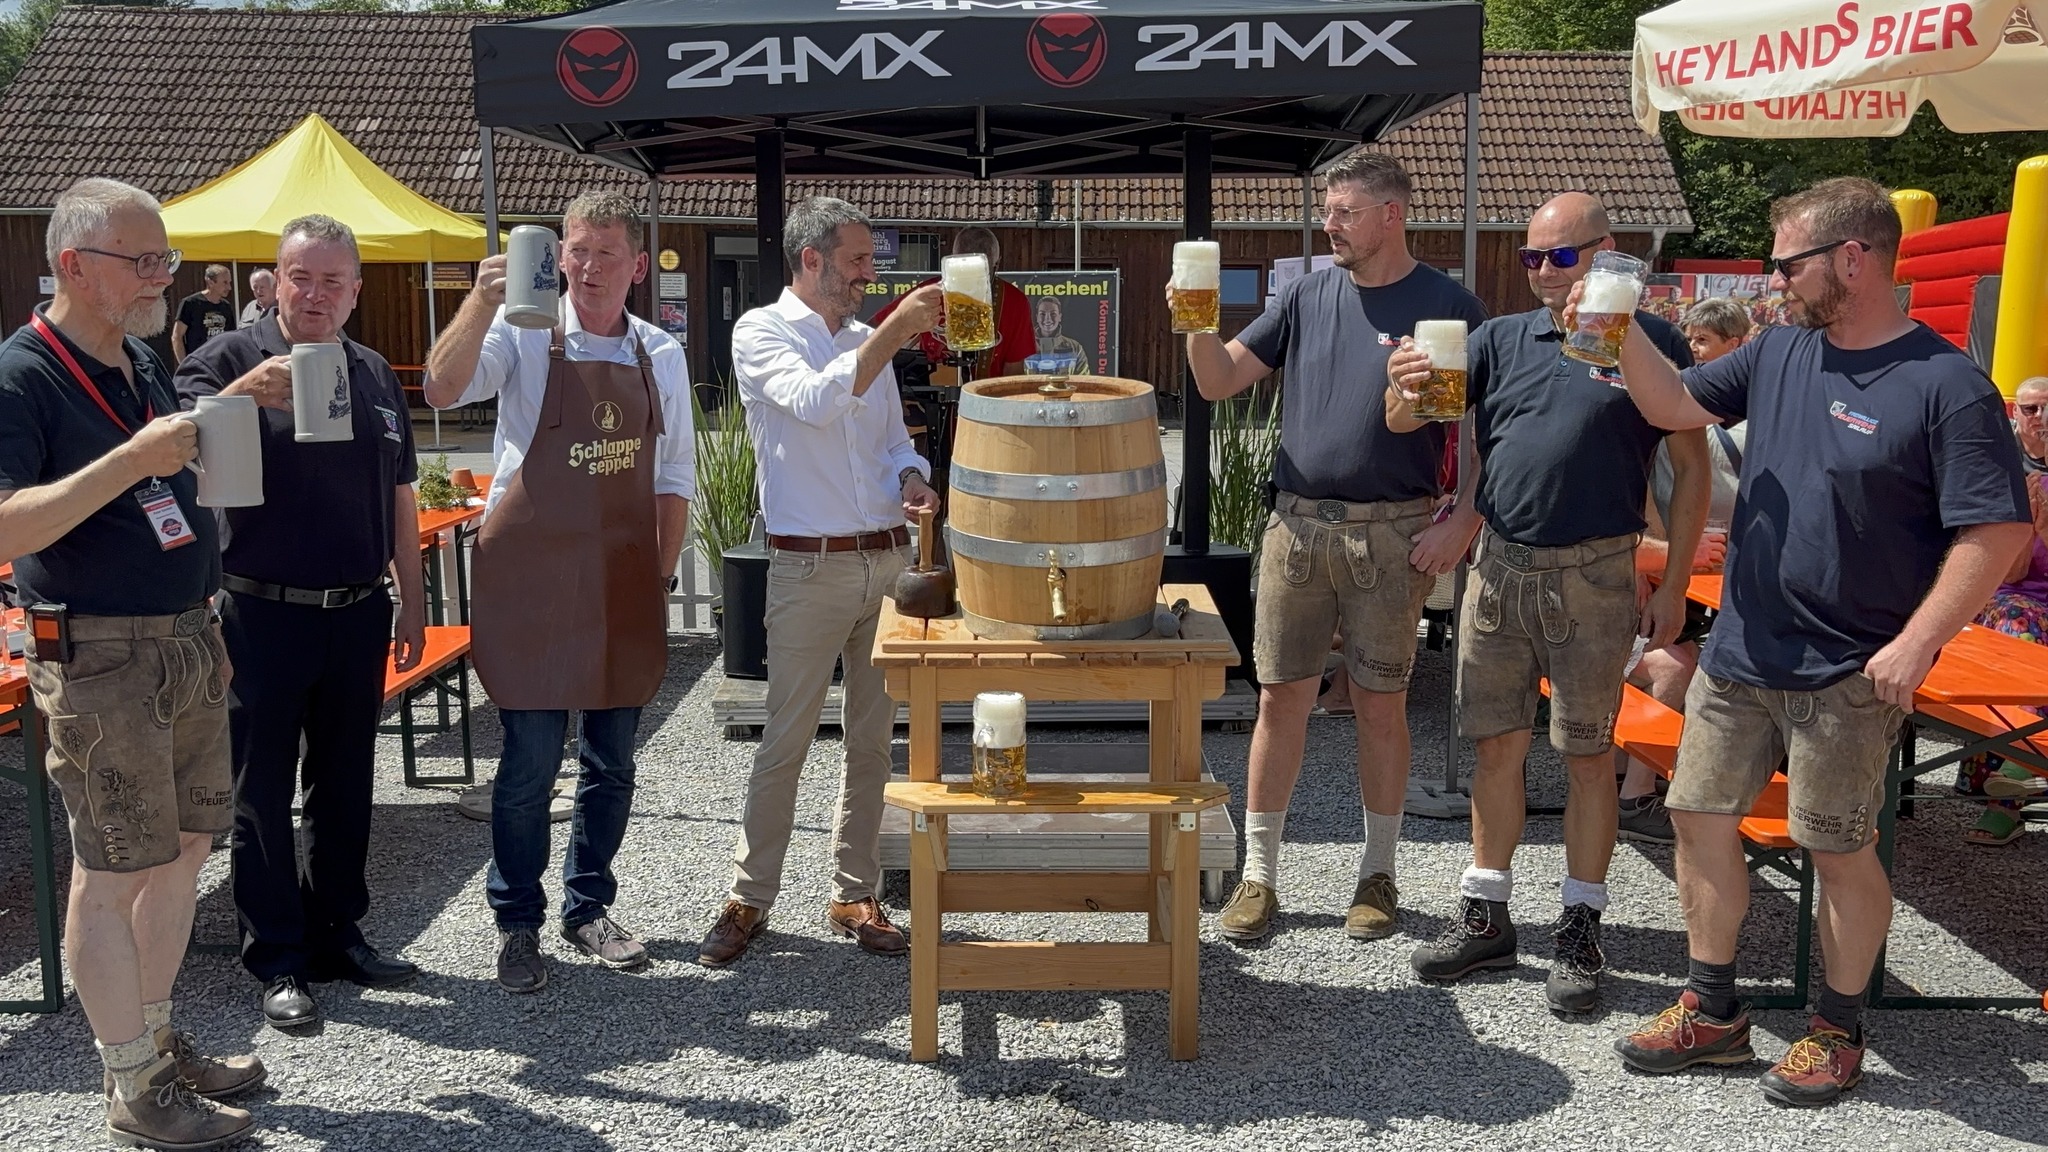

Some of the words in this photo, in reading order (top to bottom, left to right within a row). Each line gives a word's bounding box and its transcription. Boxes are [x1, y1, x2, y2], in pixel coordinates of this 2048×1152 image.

[1865, 3, 1978, 59] BIER
[1135, 20, 1418, 71] 24MX
[667, 30, 952, 89] 24MX
[865, 282, 888, 295] as
[1024, 280, 1108, 296] machen!
[1098, 300, 1109, 355] Könntest
[1098, 358, 1108, 374] Du
[568, 437, 642, 468] Schlappe
[588, 452, 636, 476] seppel
[1552, 719, 1599, 735] EUERWEHR
[1790, 806, 1843, 829] EUERWEHR
[1805, 823, 1841, 835] SAILAUF
